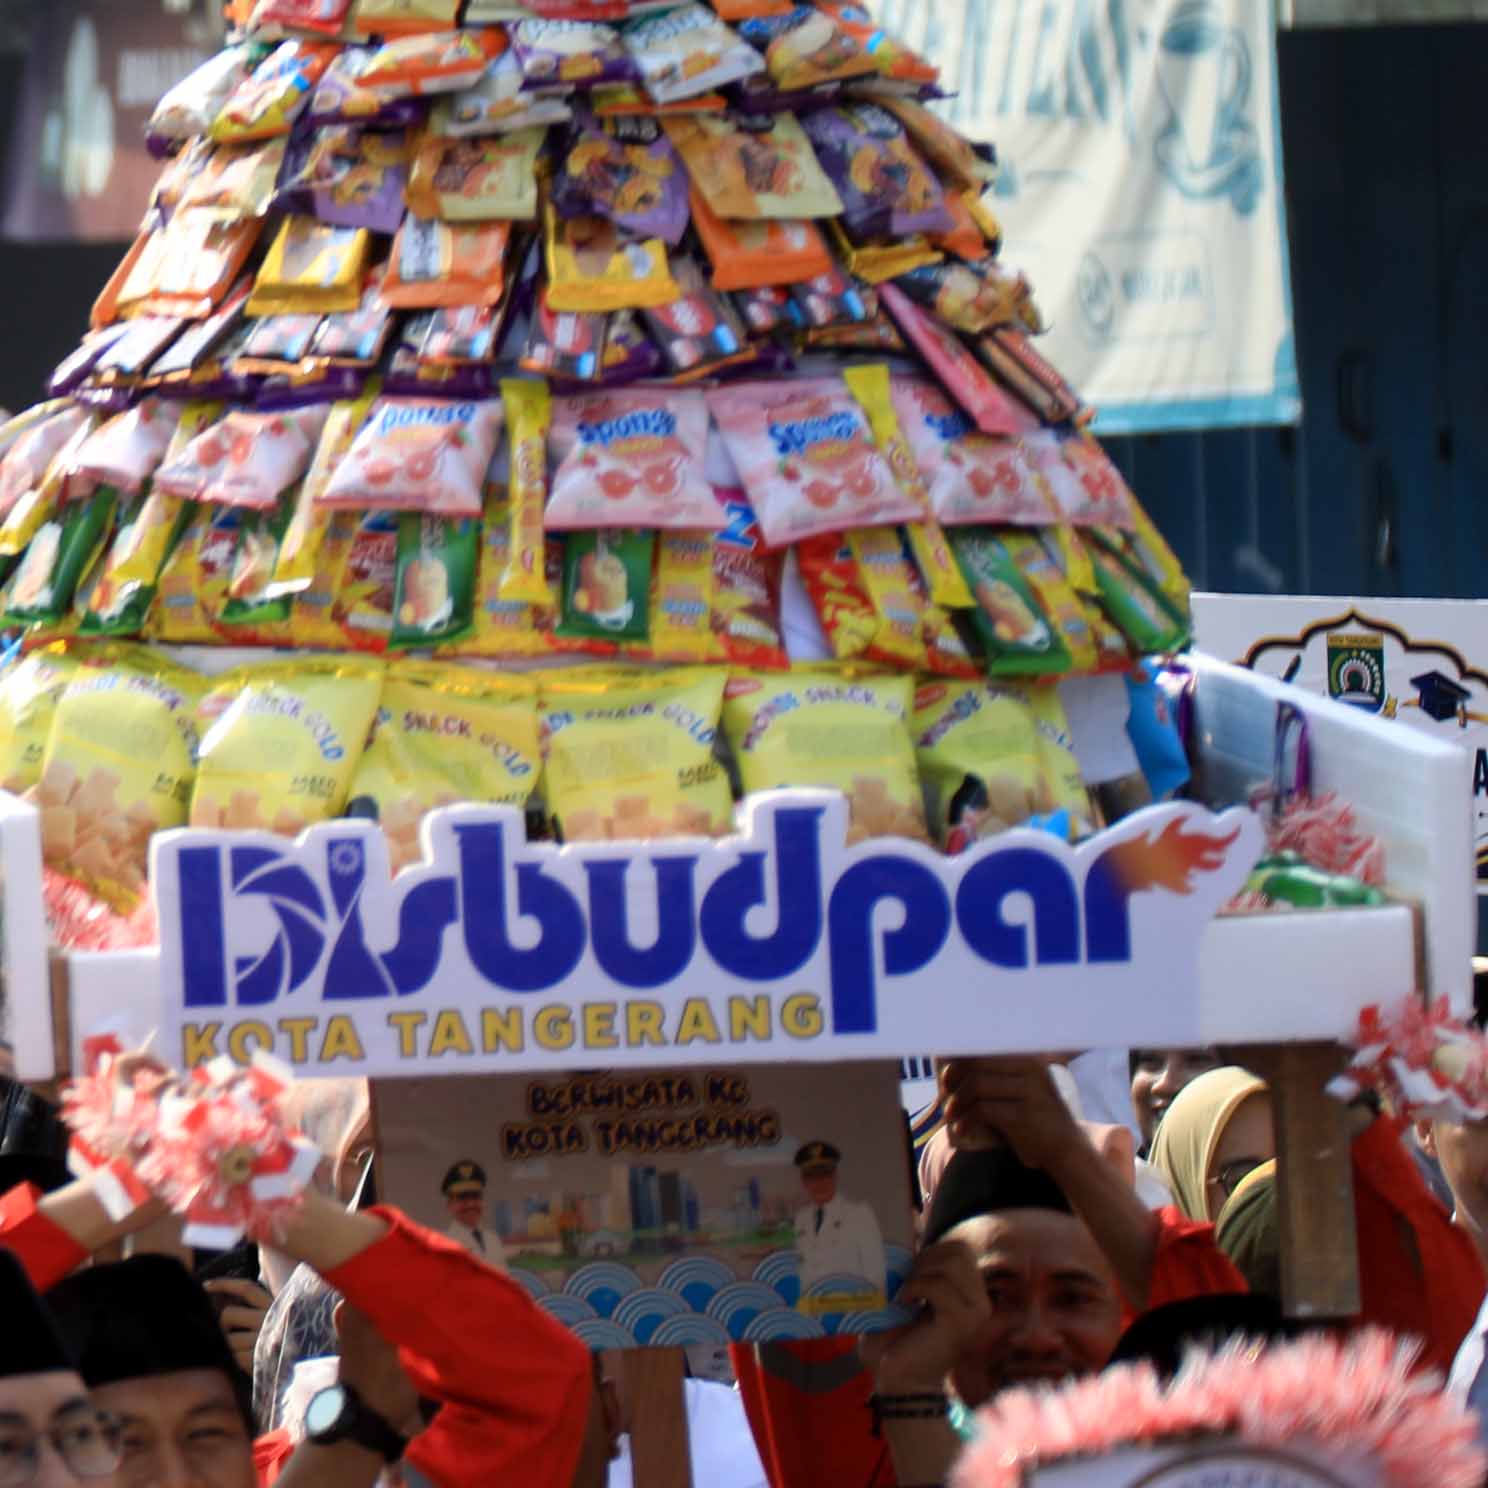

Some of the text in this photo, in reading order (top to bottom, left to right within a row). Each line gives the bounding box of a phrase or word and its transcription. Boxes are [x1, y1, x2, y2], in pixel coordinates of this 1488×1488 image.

[178, 806, 1134, 1036] Disbudpar
[181, 991, 826, 1066] KOTA TANGERANG
[502, 1112, 780, 1158] KOTA TANGERANG
